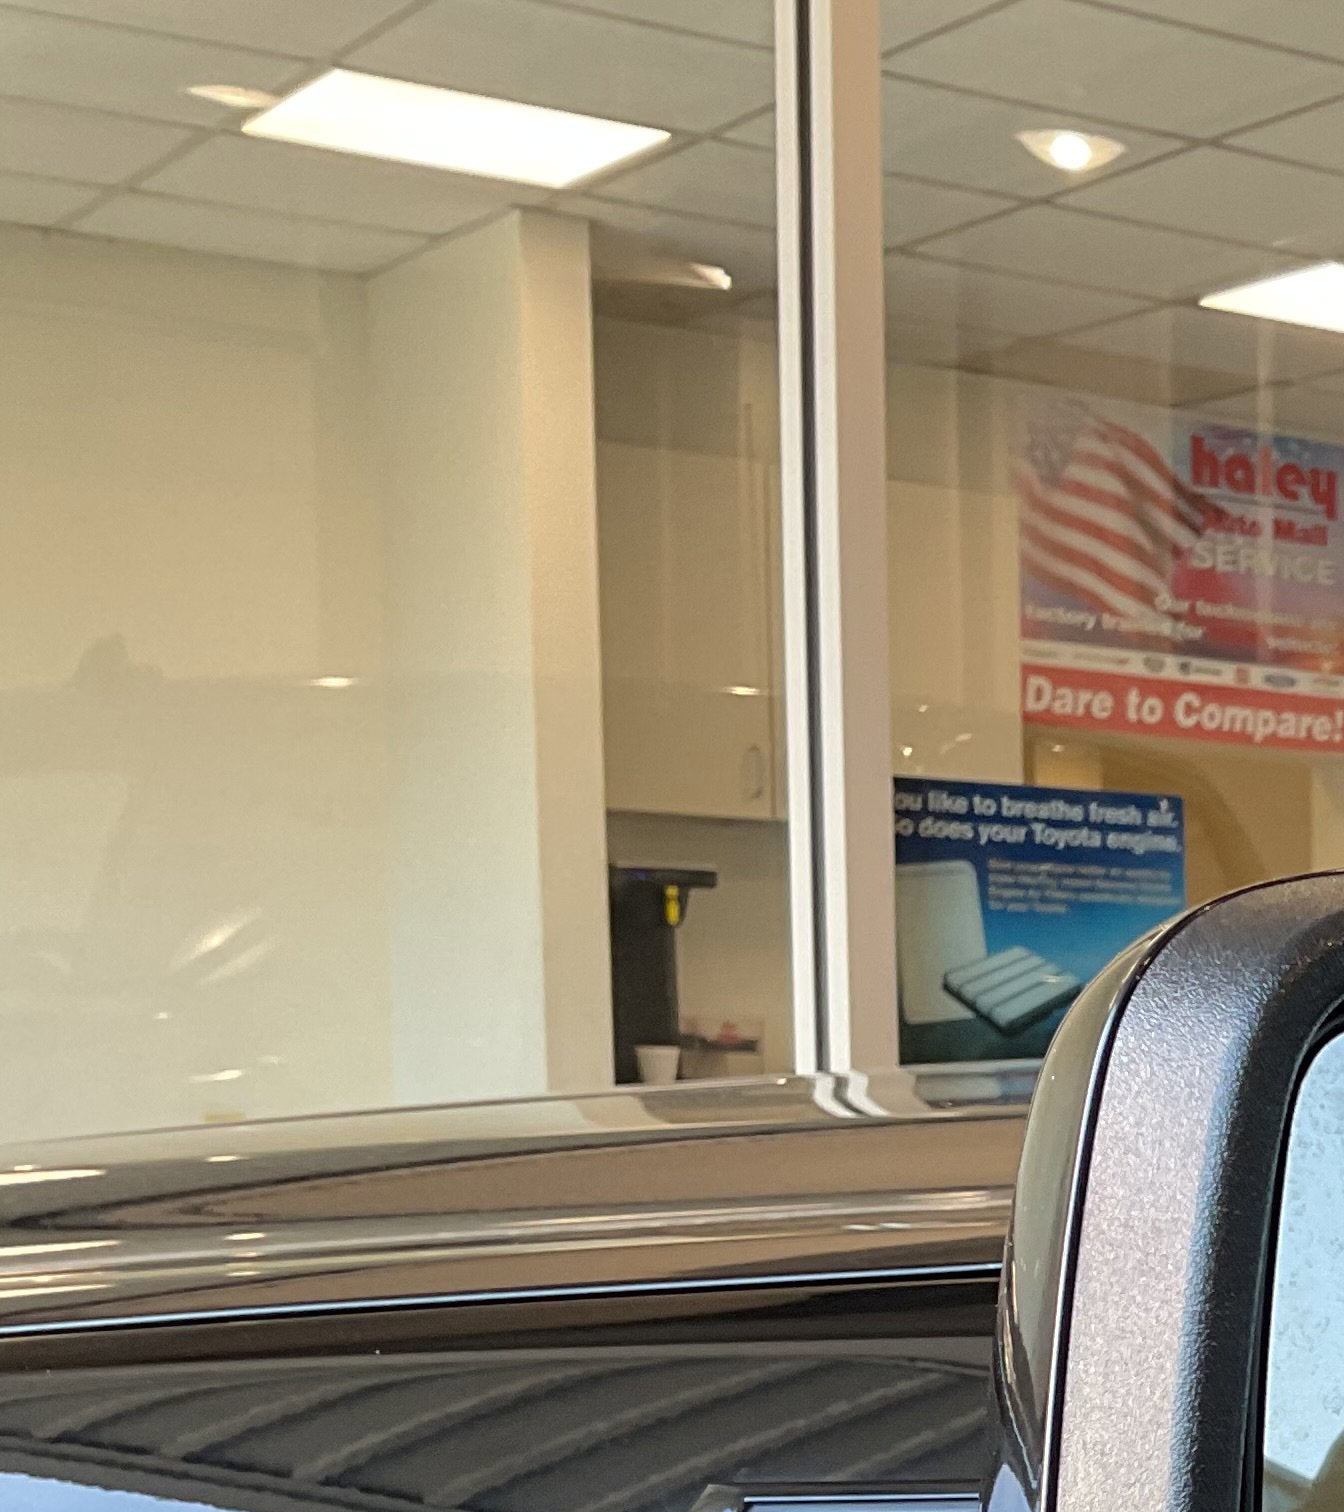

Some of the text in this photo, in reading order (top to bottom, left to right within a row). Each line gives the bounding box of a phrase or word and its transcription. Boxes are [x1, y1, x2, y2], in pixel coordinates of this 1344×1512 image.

[1191, 434, 1339, 521] haley
[1192, 540, 1336, 586] SERVICE
[1025, 675, 1344, 743] Dare to Compare!
[895, 792, 922, 811] ou
[928, 790, 968, 814] like
[973, 795, 997, 816] to
[1001, 796, 1084, 822] breathe
[1089, 802, 1142, 825] fresh
[895, 818, 914, 836] o
[918, 817, 974, 840] does
[978, 823, 1027, 845] your
[1029, 822, 1102, 849] Toyota
